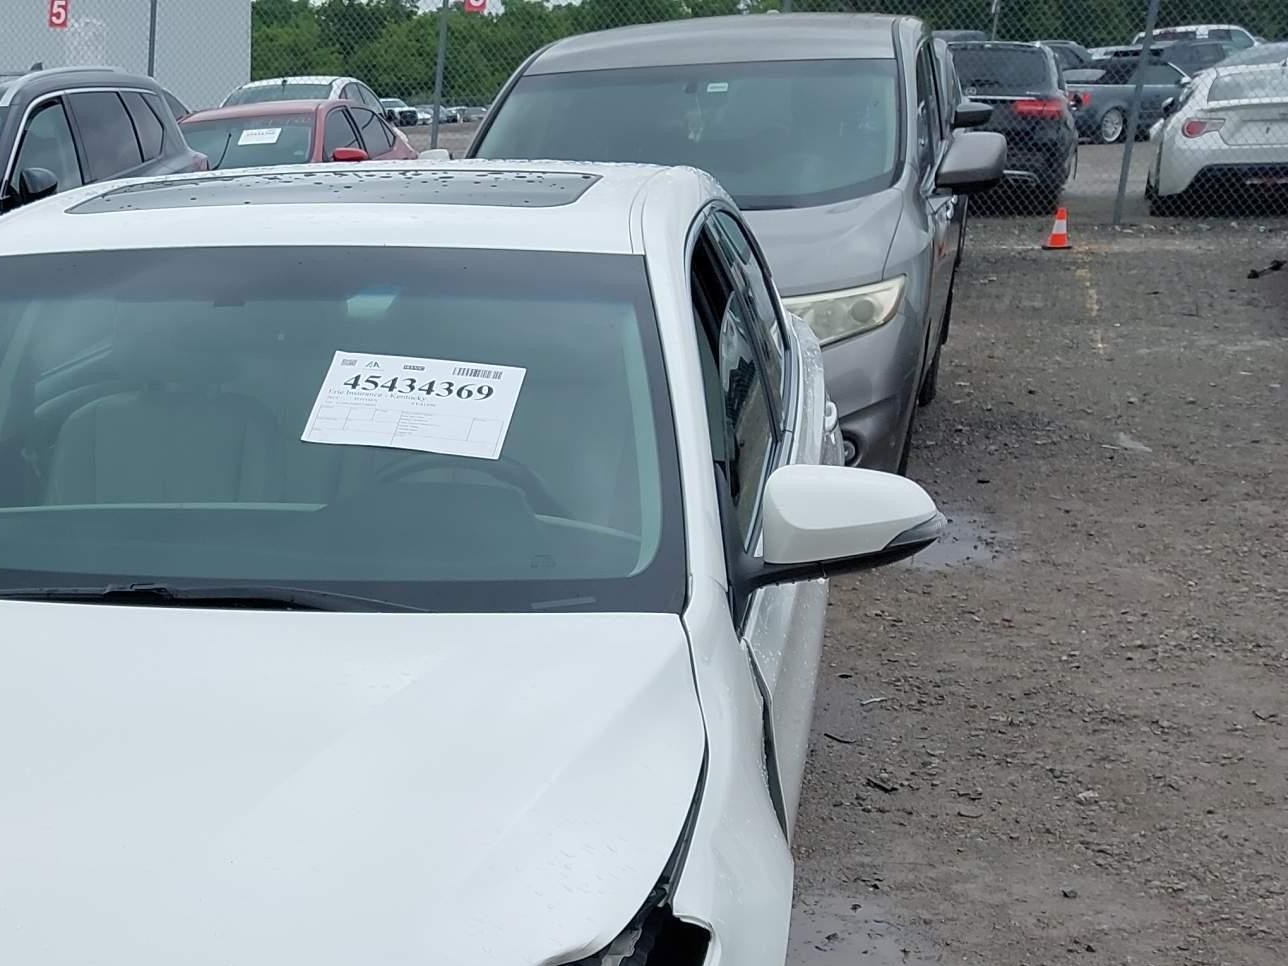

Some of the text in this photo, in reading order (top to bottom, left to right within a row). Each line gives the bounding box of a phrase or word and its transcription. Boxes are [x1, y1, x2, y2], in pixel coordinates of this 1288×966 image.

[51, 0, 66, 25] 5
[343, 374, 494, 400] 45434369
[346, 389, 383, 398] Insurance
[390, 392, 426, 402] Kentucky
